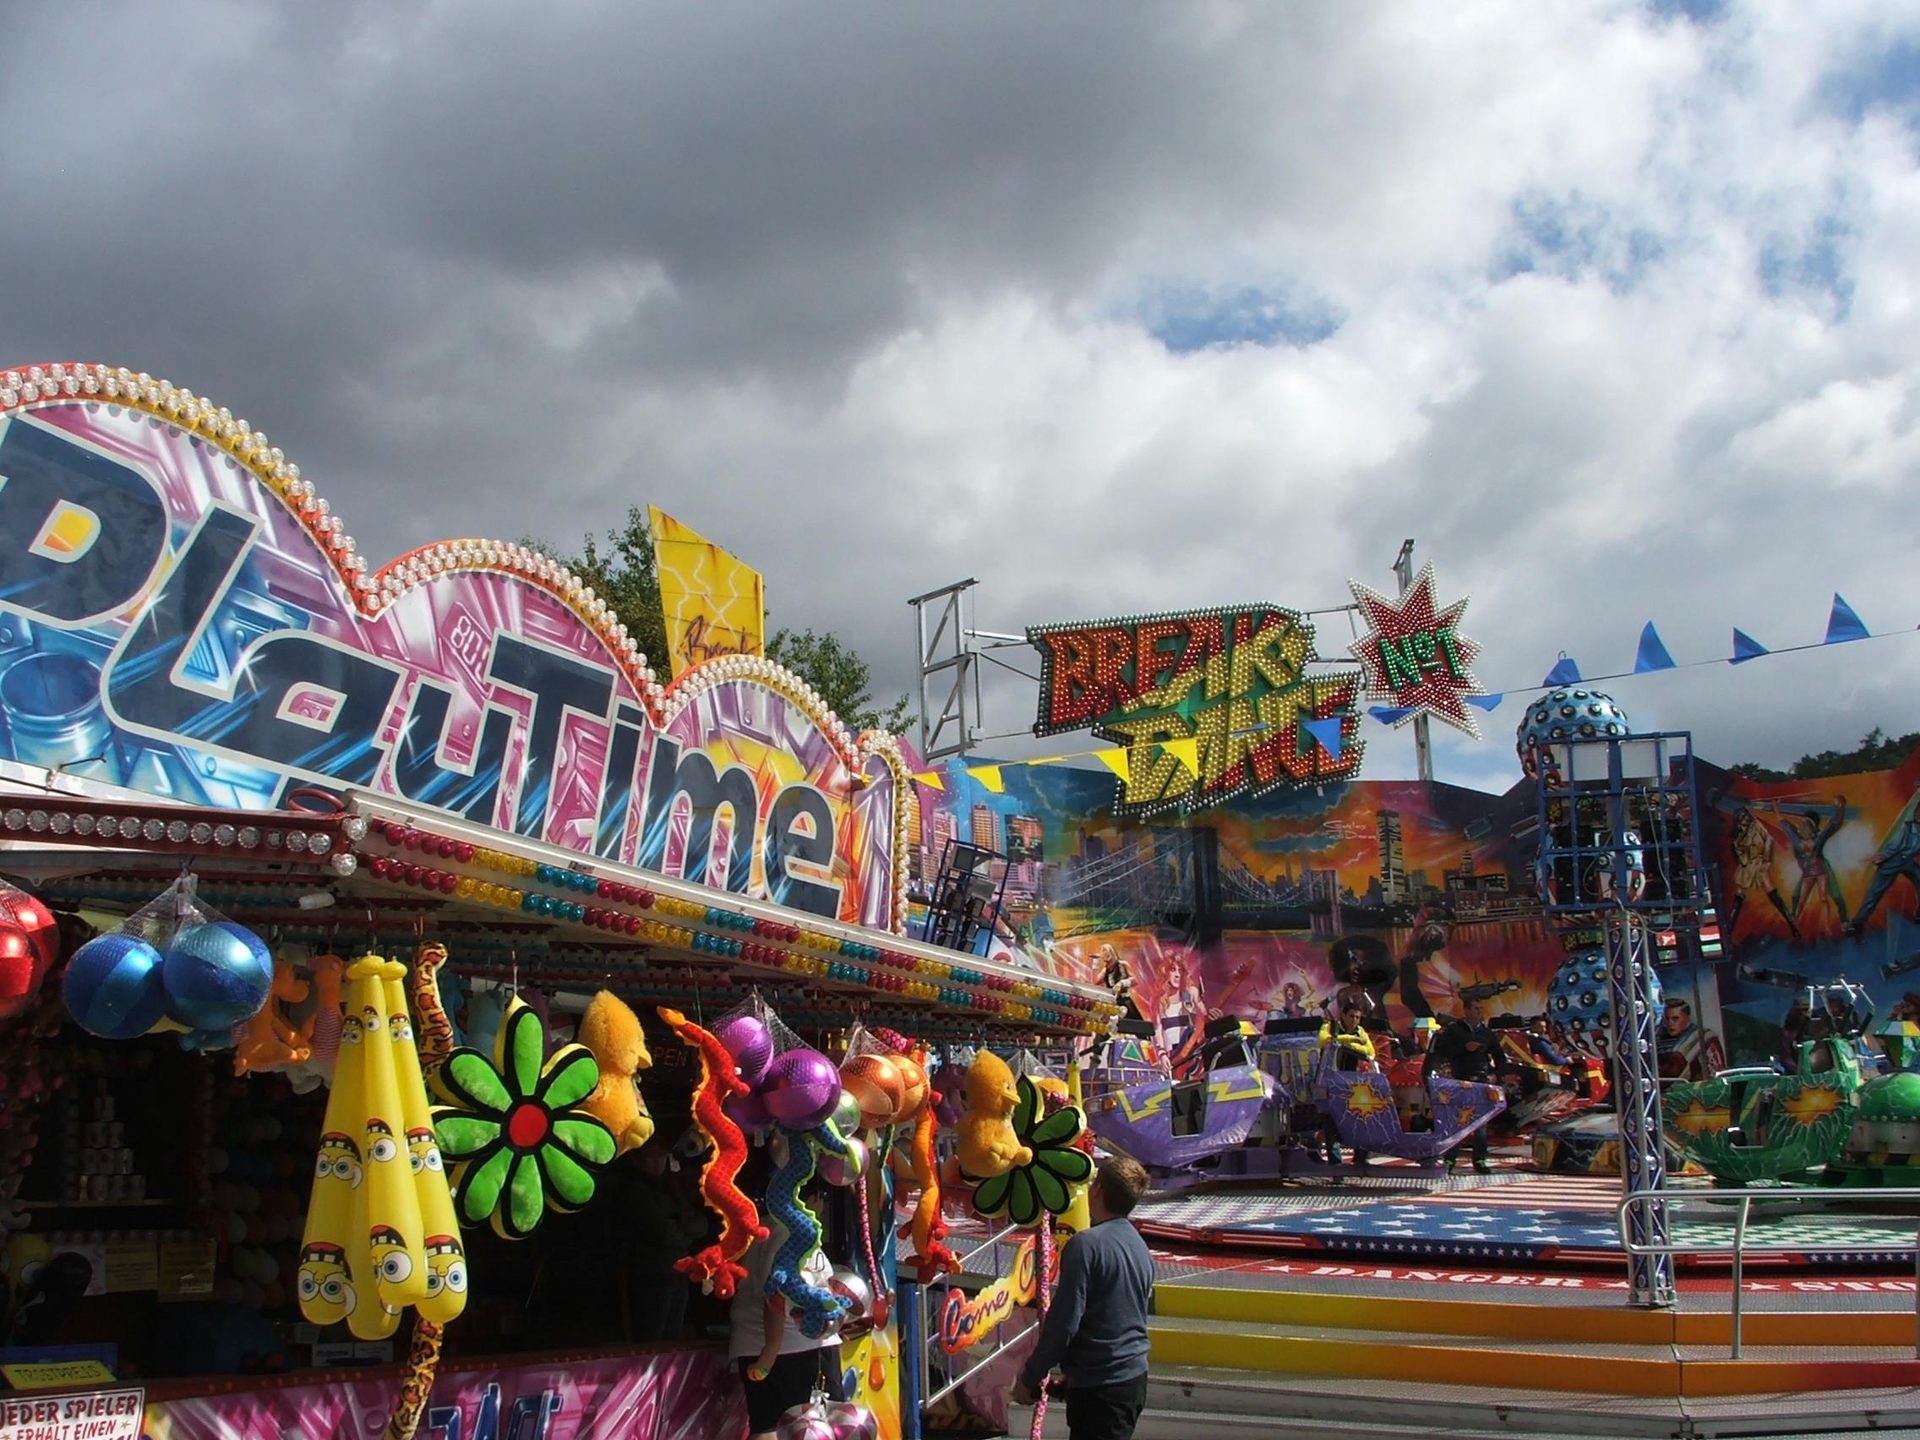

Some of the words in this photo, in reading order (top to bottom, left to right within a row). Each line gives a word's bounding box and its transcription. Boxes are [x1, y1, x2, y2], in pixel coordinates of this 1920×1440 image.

[1044, 608, 1306, 725] BREAK
[1104, 678, 1357, 805] DANCE
[653, 1046, 688, 1069] PEN
[1310, 1266, 1586, 1289] DANGER
[1790, 1281, 1918, 1292] STO
[945, 1290, 1009, 1347] Come
[0, 1401, 60, 1431] JEDER
[64, 1395, 139, 1420] SPIELER
[74, 1420, 117, 1440] EINEN
